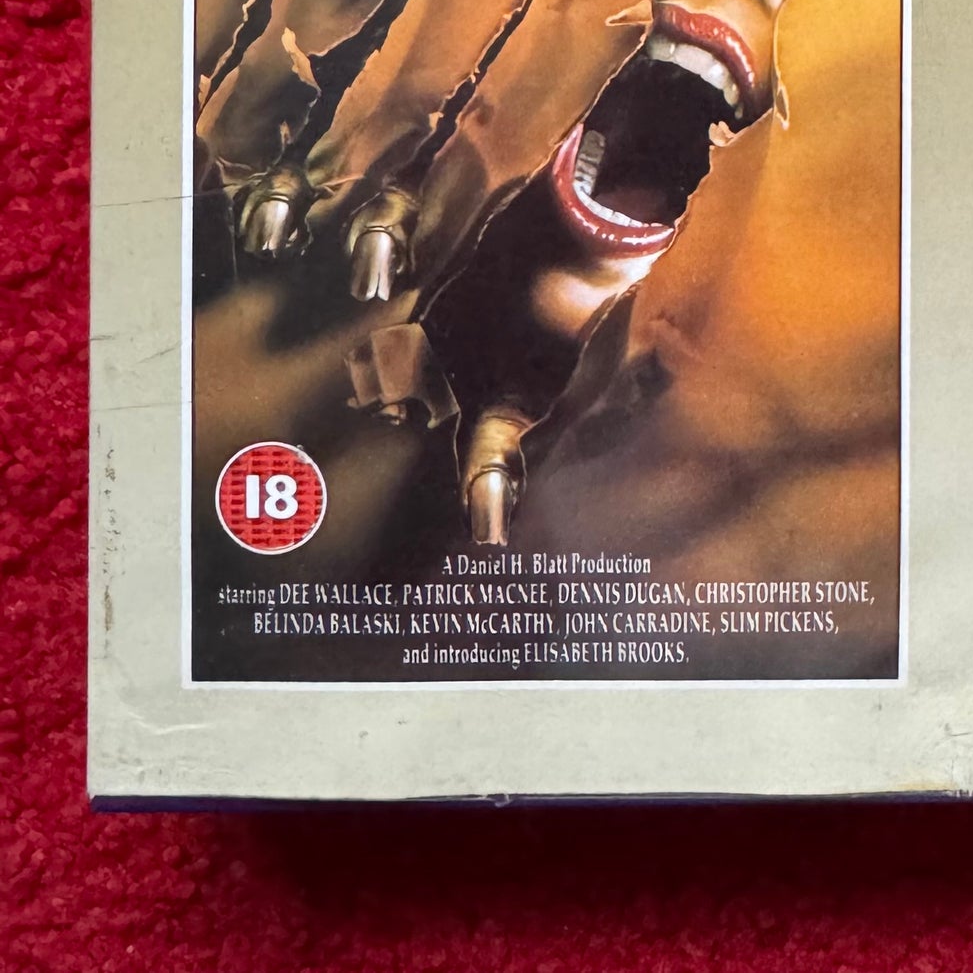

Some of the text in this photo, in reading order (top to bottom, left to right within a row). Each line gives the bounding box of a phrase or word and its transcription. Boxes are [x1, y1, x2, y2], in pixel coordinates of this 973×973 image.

[245, 474, 298, 519] 18
[442, 553, 651, 575] A Daniel H. Blatt Production
[217, 581, 875, 611] starring DEE WALLACE, PATRICK MACNEE, DENNIS DUGAN, CHRISTOPHER STONE,
[254, 610, 839, 639] BELINDA BALASKI, KEVIN McCARTHY, JOHN CARRADINE, SLIM PICKENS,
[403, 644, 430, 664] and
[434, 643, 520, 670] introducing
[524, 642, 613, 664] ELISABETH
